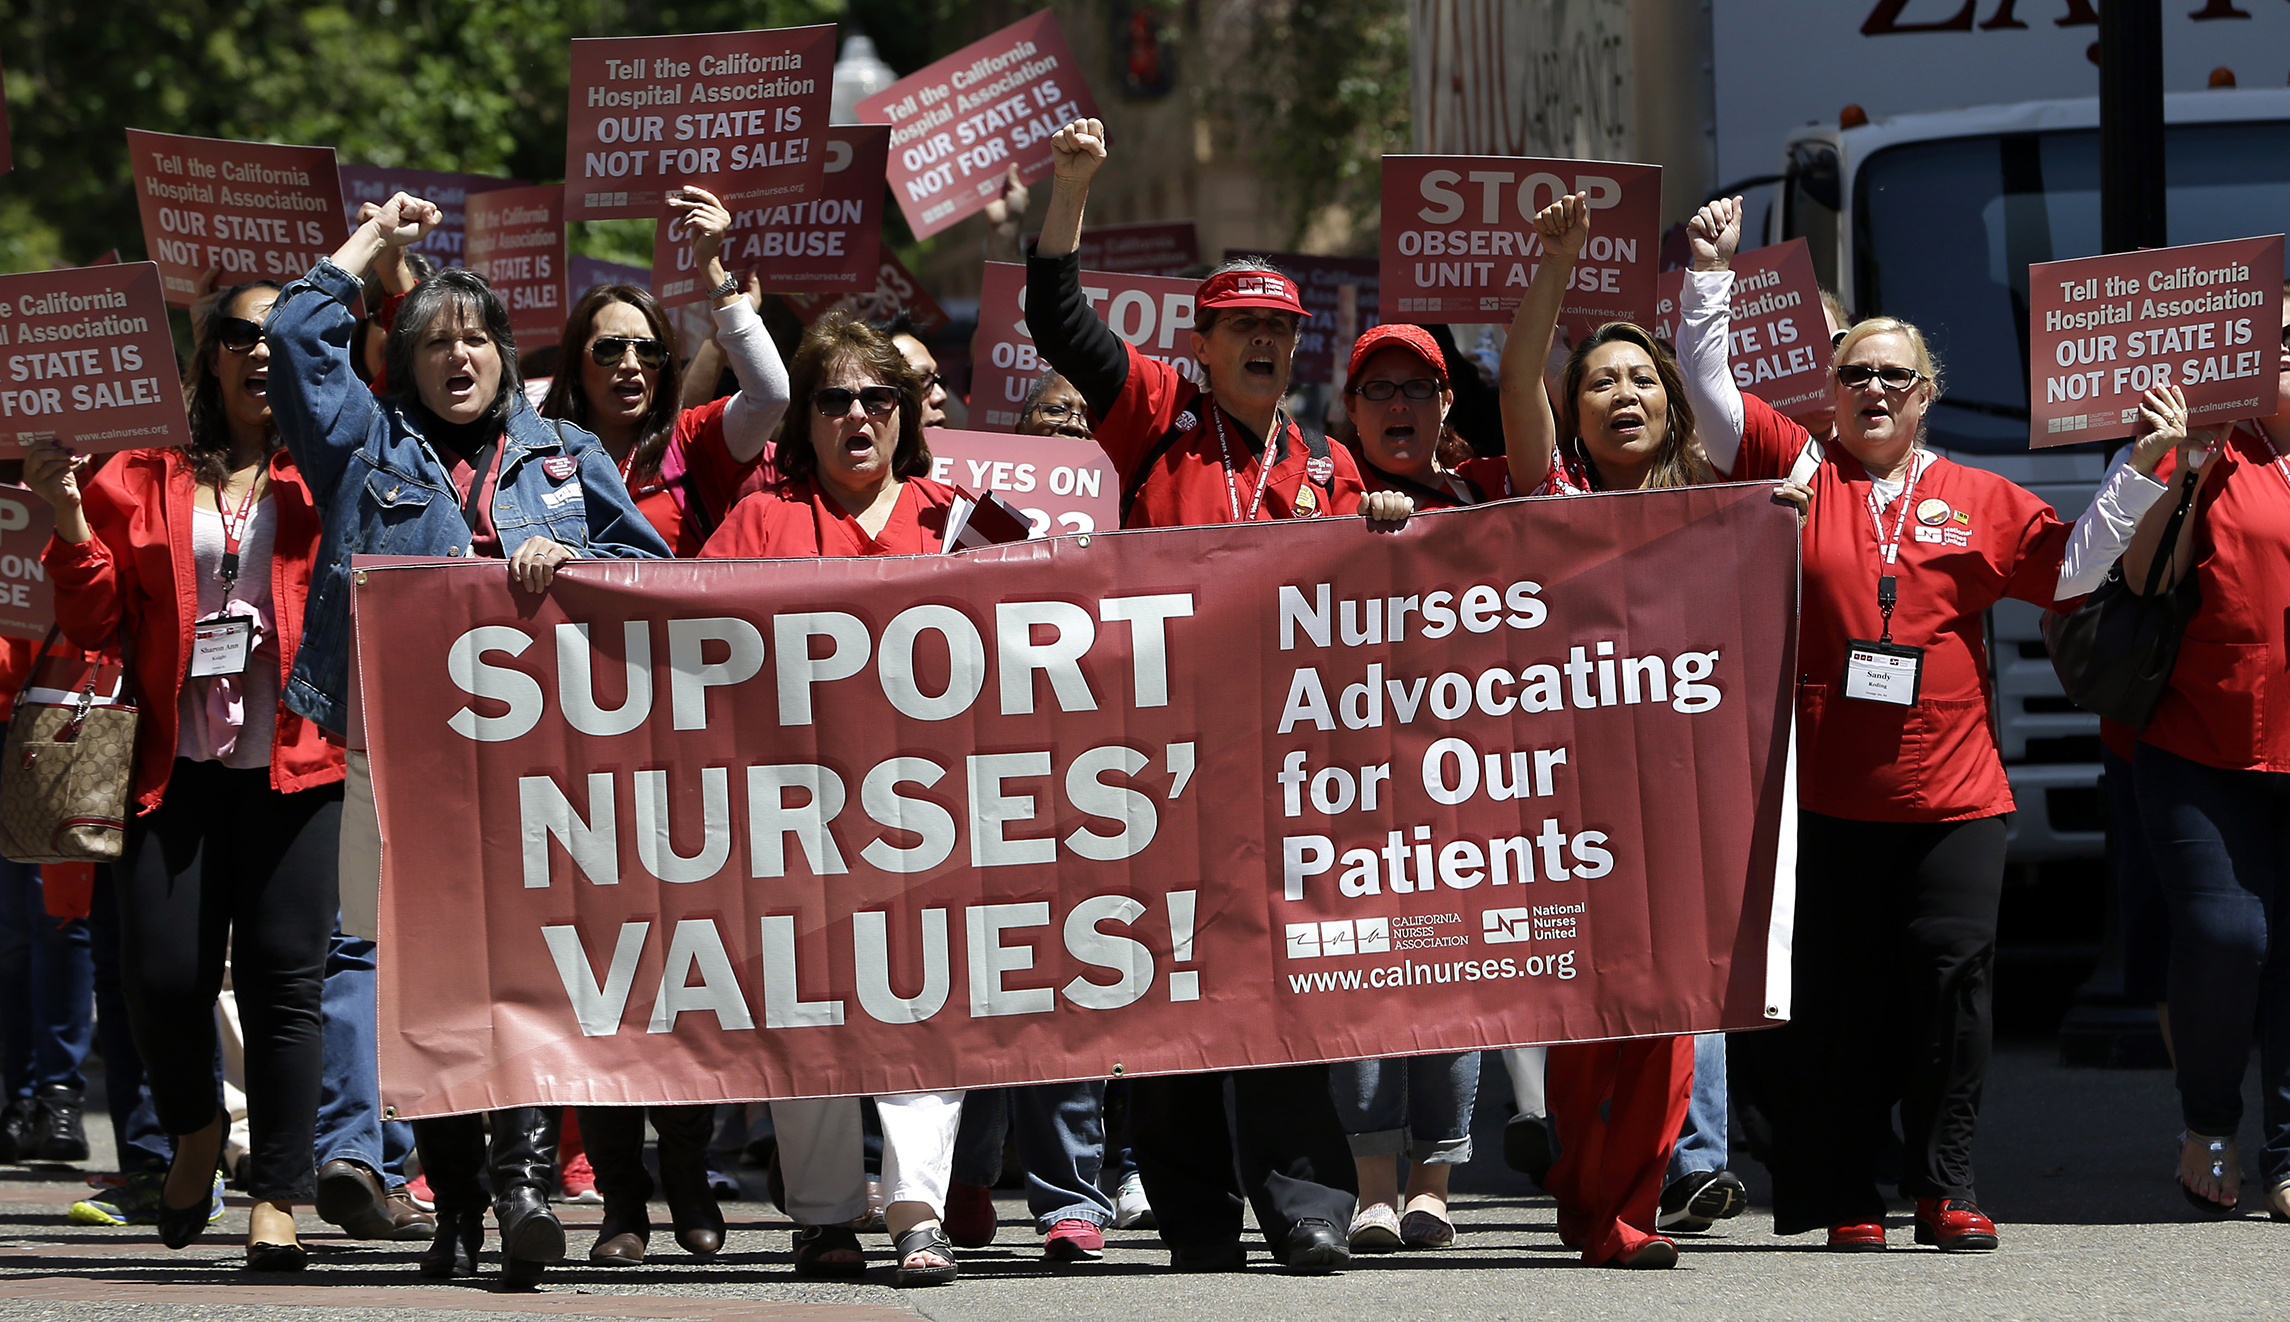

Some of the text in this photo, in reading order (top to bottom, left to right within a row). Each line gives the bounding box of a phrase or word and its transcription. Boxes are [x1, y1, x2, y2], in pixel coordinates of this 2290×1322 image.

[605, 50, 802, 80] Tell the California
[883, 40, 1037, 124] Tell the California
[588, 76, 815, 110] Hospital Association
[956, 55, 1059, 114] Association
[597, 106, 802, 144] OUR STATE IS
[902, 80, 1062, 172] OUR STATE IS
[152, 153, 310, 186] Tell the California
[585, 150, 649, 178] NOT
[658, 148, 721, 175] FOR
[730, 138, 809, 171] SALE!
[905, 162, 956, 203] NOT
[956, 136, 1010, 177] FOR
[1010, 100, 1083, 150] SALE!
[146, 176, 328, 212] Hospital Association
[722, 183, 804, 201] www.calnurses.org
[1417, 169, 1622, 224] STOP
[159, 207, 324, 245] OUR STATE IS
[499, 228, 556, 249] Association
[157, 237, 201, 267] NOT
[206, 245, 258, 273] FOR
[742, 232, 846, 258] ABUSE
[492, 257, 530, 281] STATE
[536, 255, 551, 278] IS
[770, 271, 856, 282] www.calnurses.org
[1415, 262, 1494, 288] UNIT
[2060, 262, 2249, 303] Tell the California
[19, 287, 127, 317] California
[513, 285, 557, 310] SALE!
[2046, 289, 2264, 332] Hospital Association
[17, 315, 149, 344] Association
[1767, 318, 1798, 347] IS
[2056, 318, 2252, 367] OUR STATE IS
[9, 344, 143, 382] STATE IS
[1733, 346, 1817, 388] SALE!
[2047, 351, 2261, 403] NOT FOR SALE!
[1, 377, 162, 417] FOR SALE!
[74, 424, 169, 442] www.calnurses.org
[966, 458, 1037, 493] YES
[1049, 466, 1101, 498] ON
[1944, 527, 1972, 536] National
[1279, 580, 1548, 650] Nurses
[200, 644, 225, 655] Sharon
[447, 592, 1195, 743] SUPPORT
[1277, 641, 1722, 734] Advocating
[1867, 671, 1891, 681] Sandy
[1278, 737, 1567, 817] for Our
[1283, 818, 1615, 901] Patients
[1392, 912, 1461, 927] CALIFORNIA
[1533, 902, 1585, 916] National
[1534, 916, 1576, 928] Nurses
[1393, 926, 1434, 938] NURSES
[1394, 935, 1469, 950] ASSOCIATION
[1535, 927, 1576, 940] United
[541, 890, 1201, 1037] VALUES!
[1288, 950, 1577, 994] www.calnurses.org
